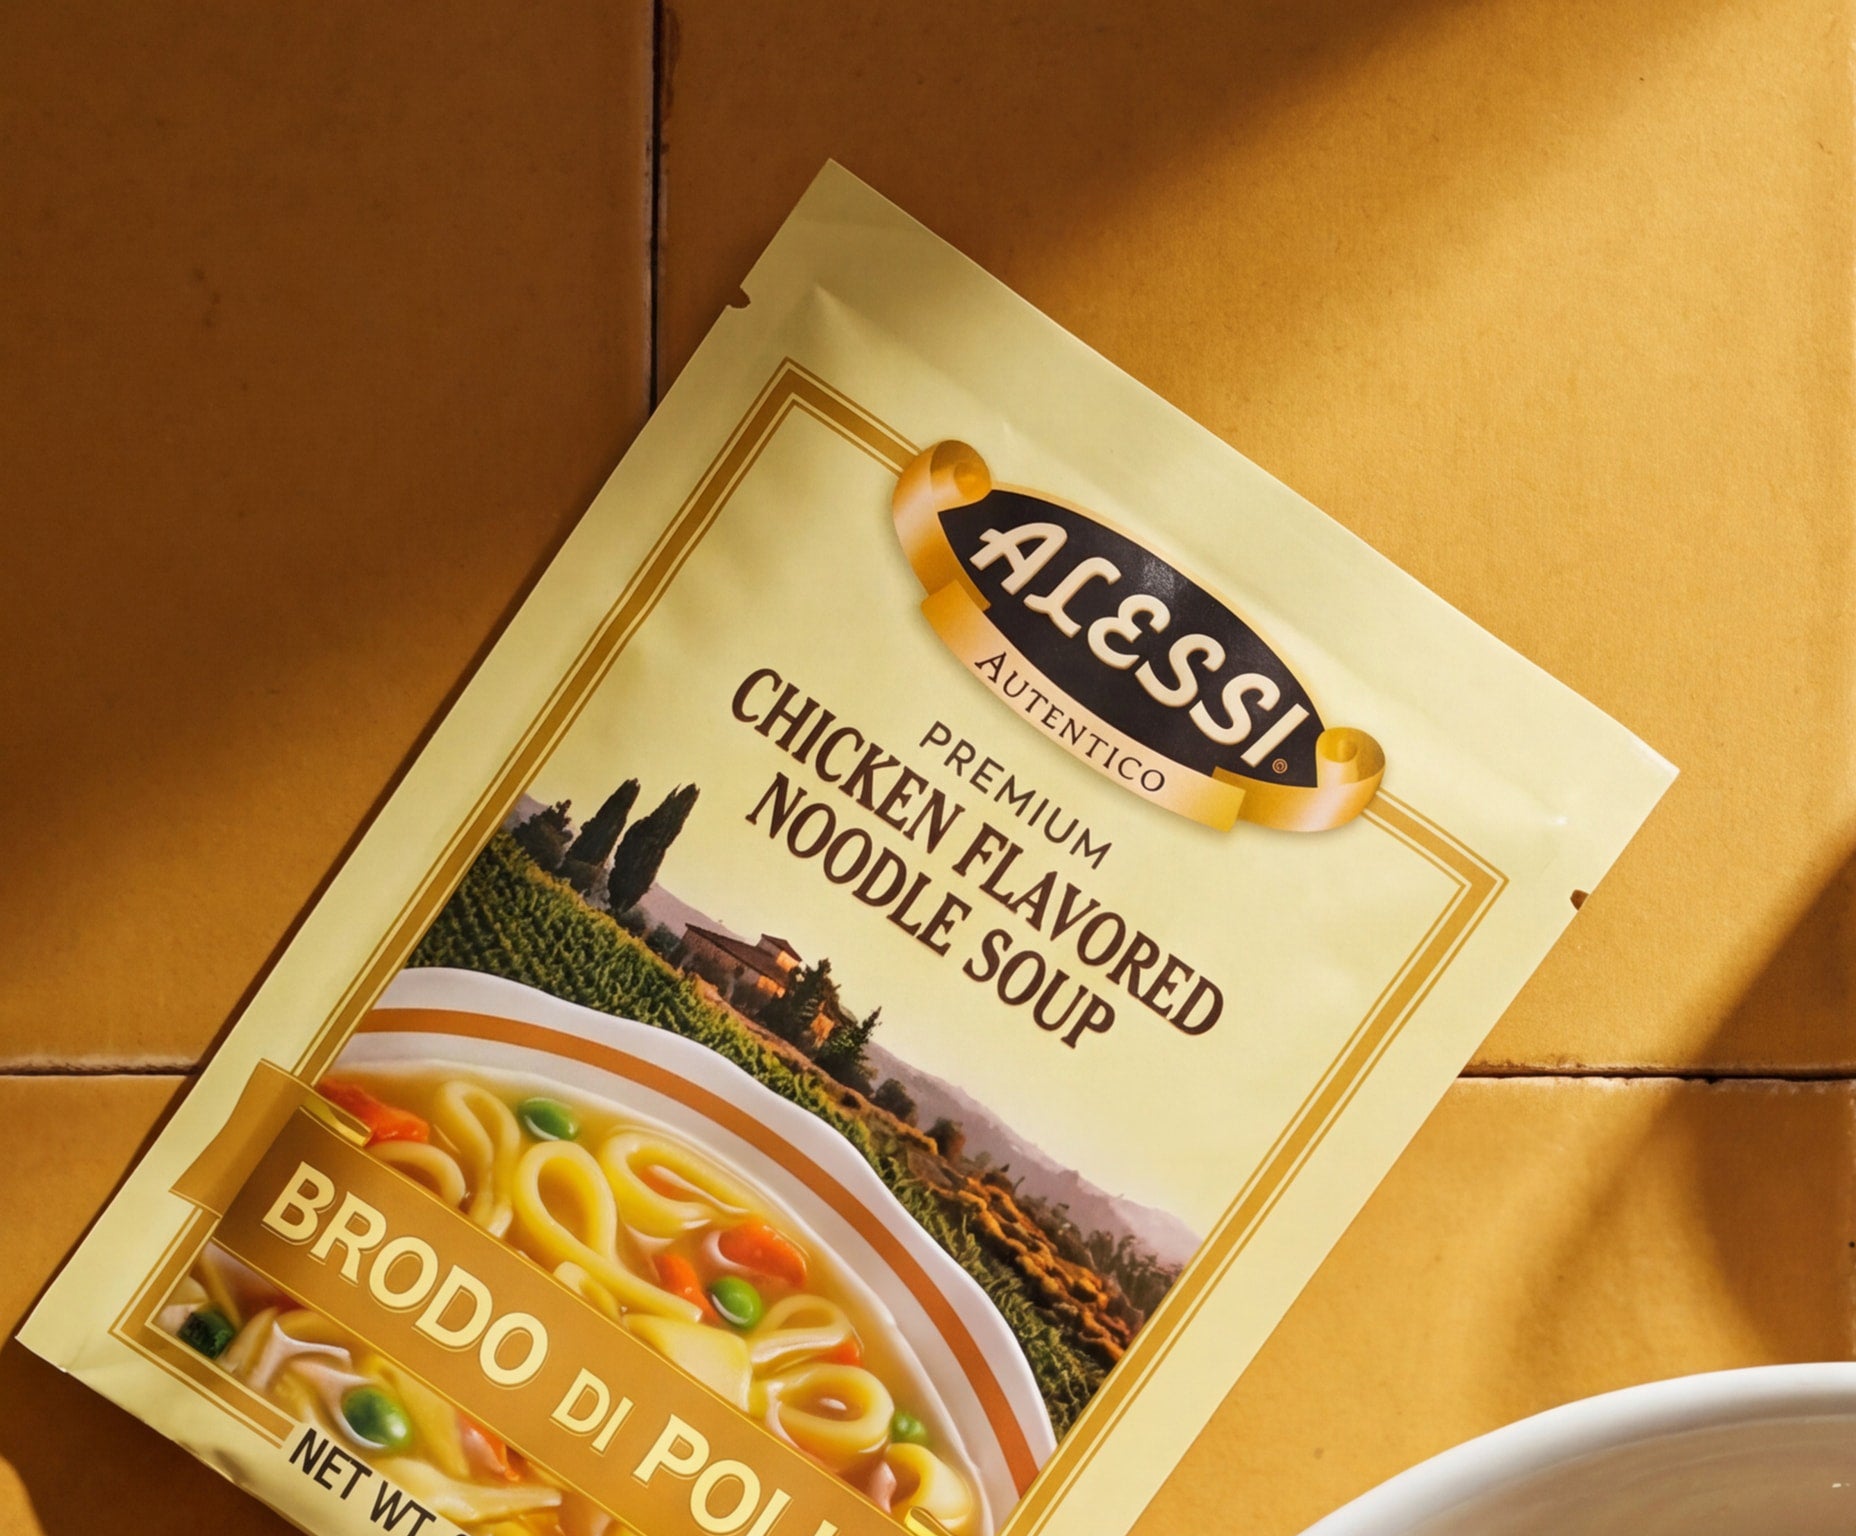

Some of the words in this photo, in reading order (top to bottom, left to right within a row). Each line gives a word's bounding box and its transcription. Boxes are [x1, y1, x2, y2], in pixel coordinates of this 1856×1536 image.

[968, 521, 1310, 768] ALESSI
[974, 650, 1166, 793] AUTENTICO
[731, 668, 965, 854] CHICKEN
[952, 822, 1224, 1036] FLAVORED
[745, 771, 973, 957] NOODLE
[962, 928, 1116, 1050] SOUP
[918, 720, 1113, 870] PREMIUM
[261, 1160, 550, 1388] BRODO
[550, 1368, 636, 1456] DI
[288, 1428, 373, 1501] NET
